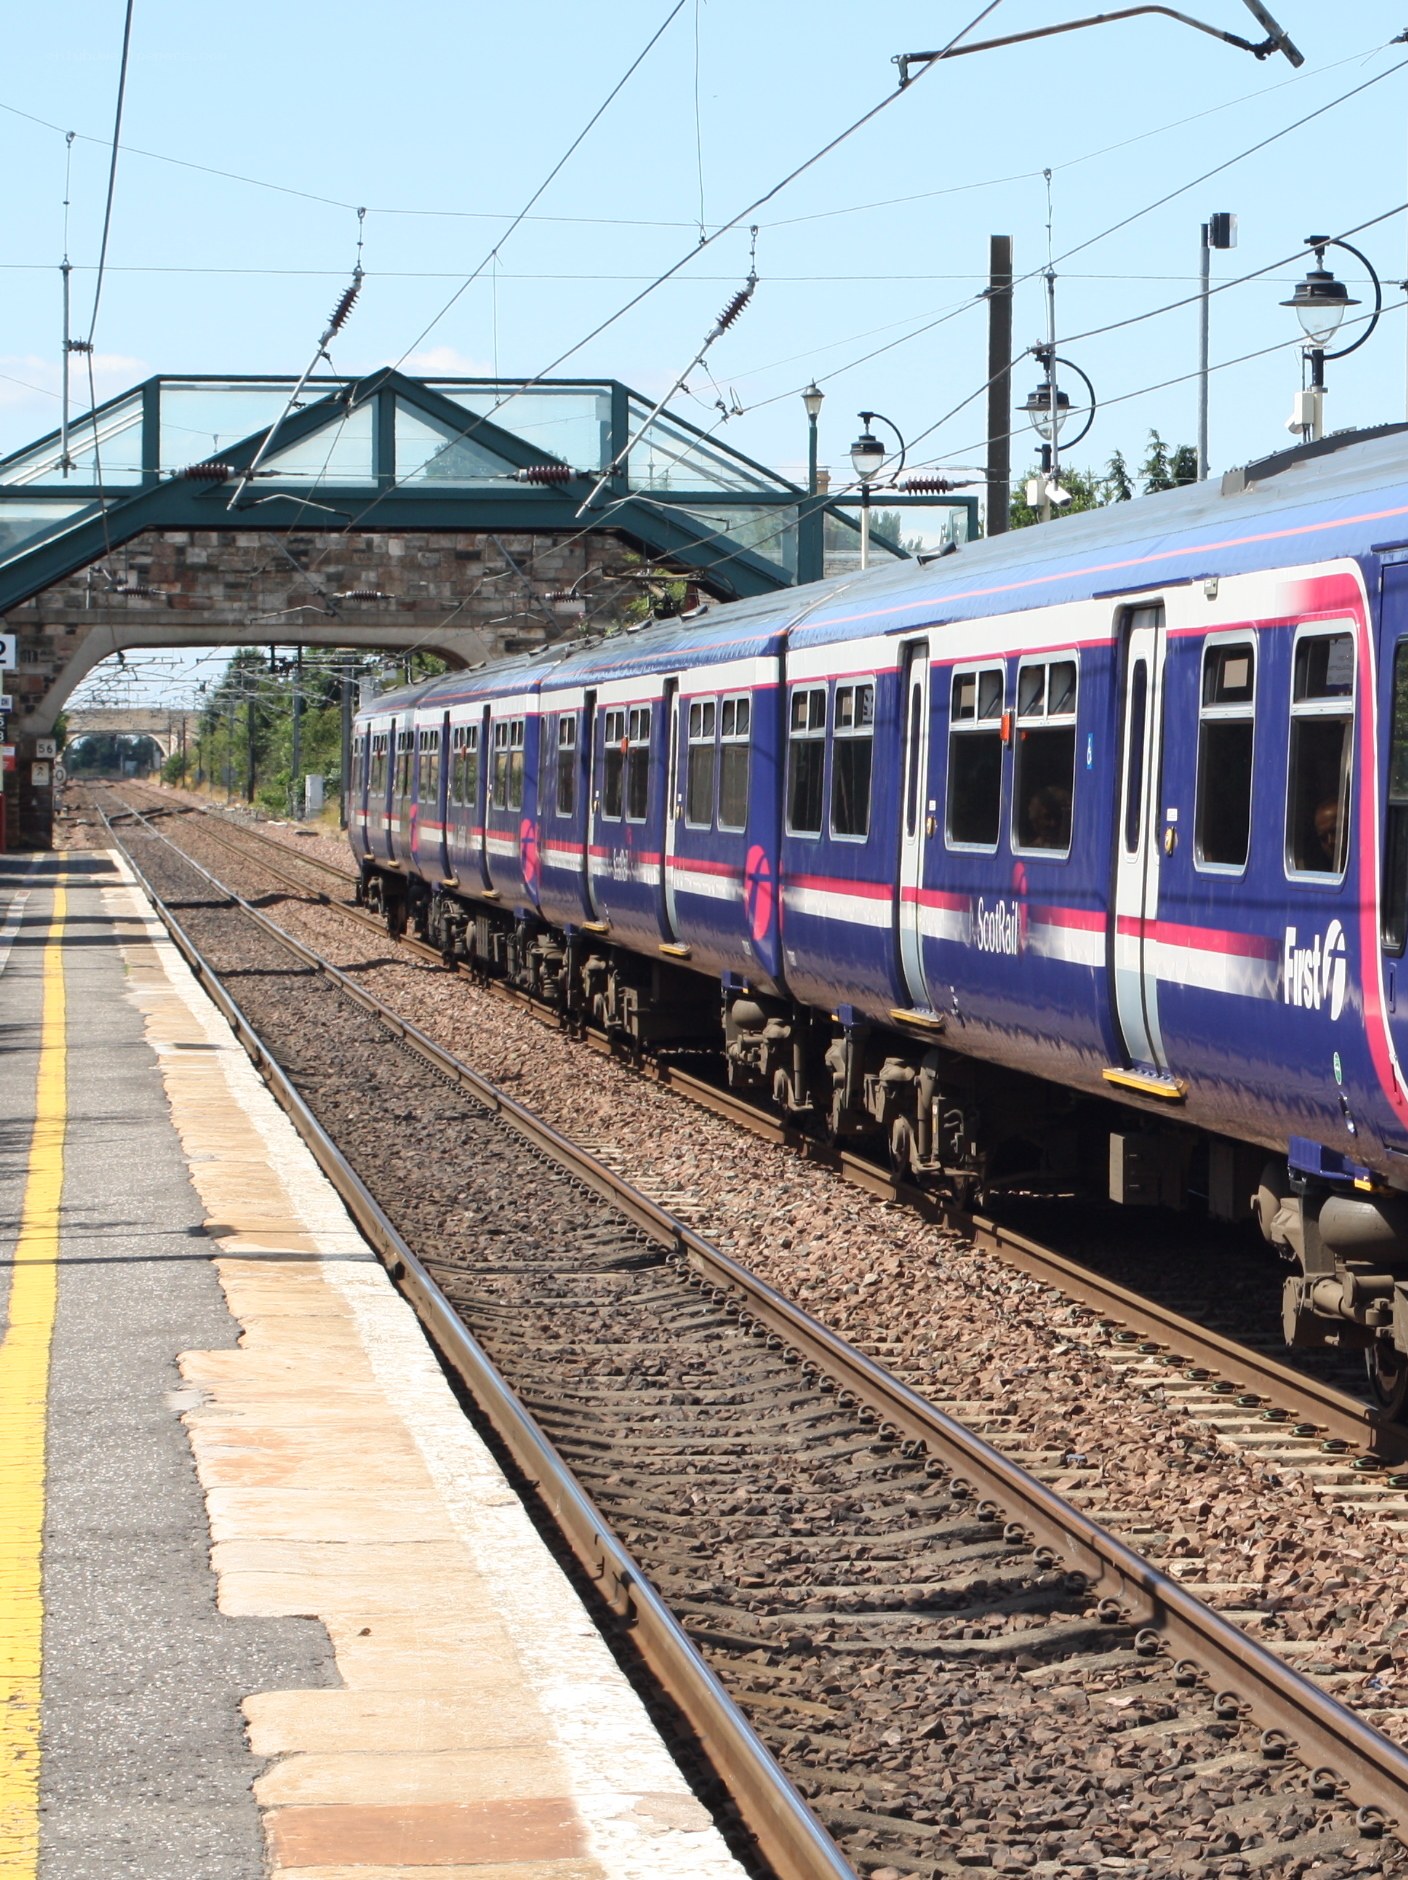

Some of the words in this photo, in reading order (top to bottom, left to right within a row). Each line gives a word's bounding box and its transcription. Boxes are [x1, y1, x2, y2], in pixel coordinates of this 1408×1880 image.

[38, 743, 54, 754] 56
[977, 896, 1019, 956] ScotRail
[1284, 926, 1321, 1010] First
